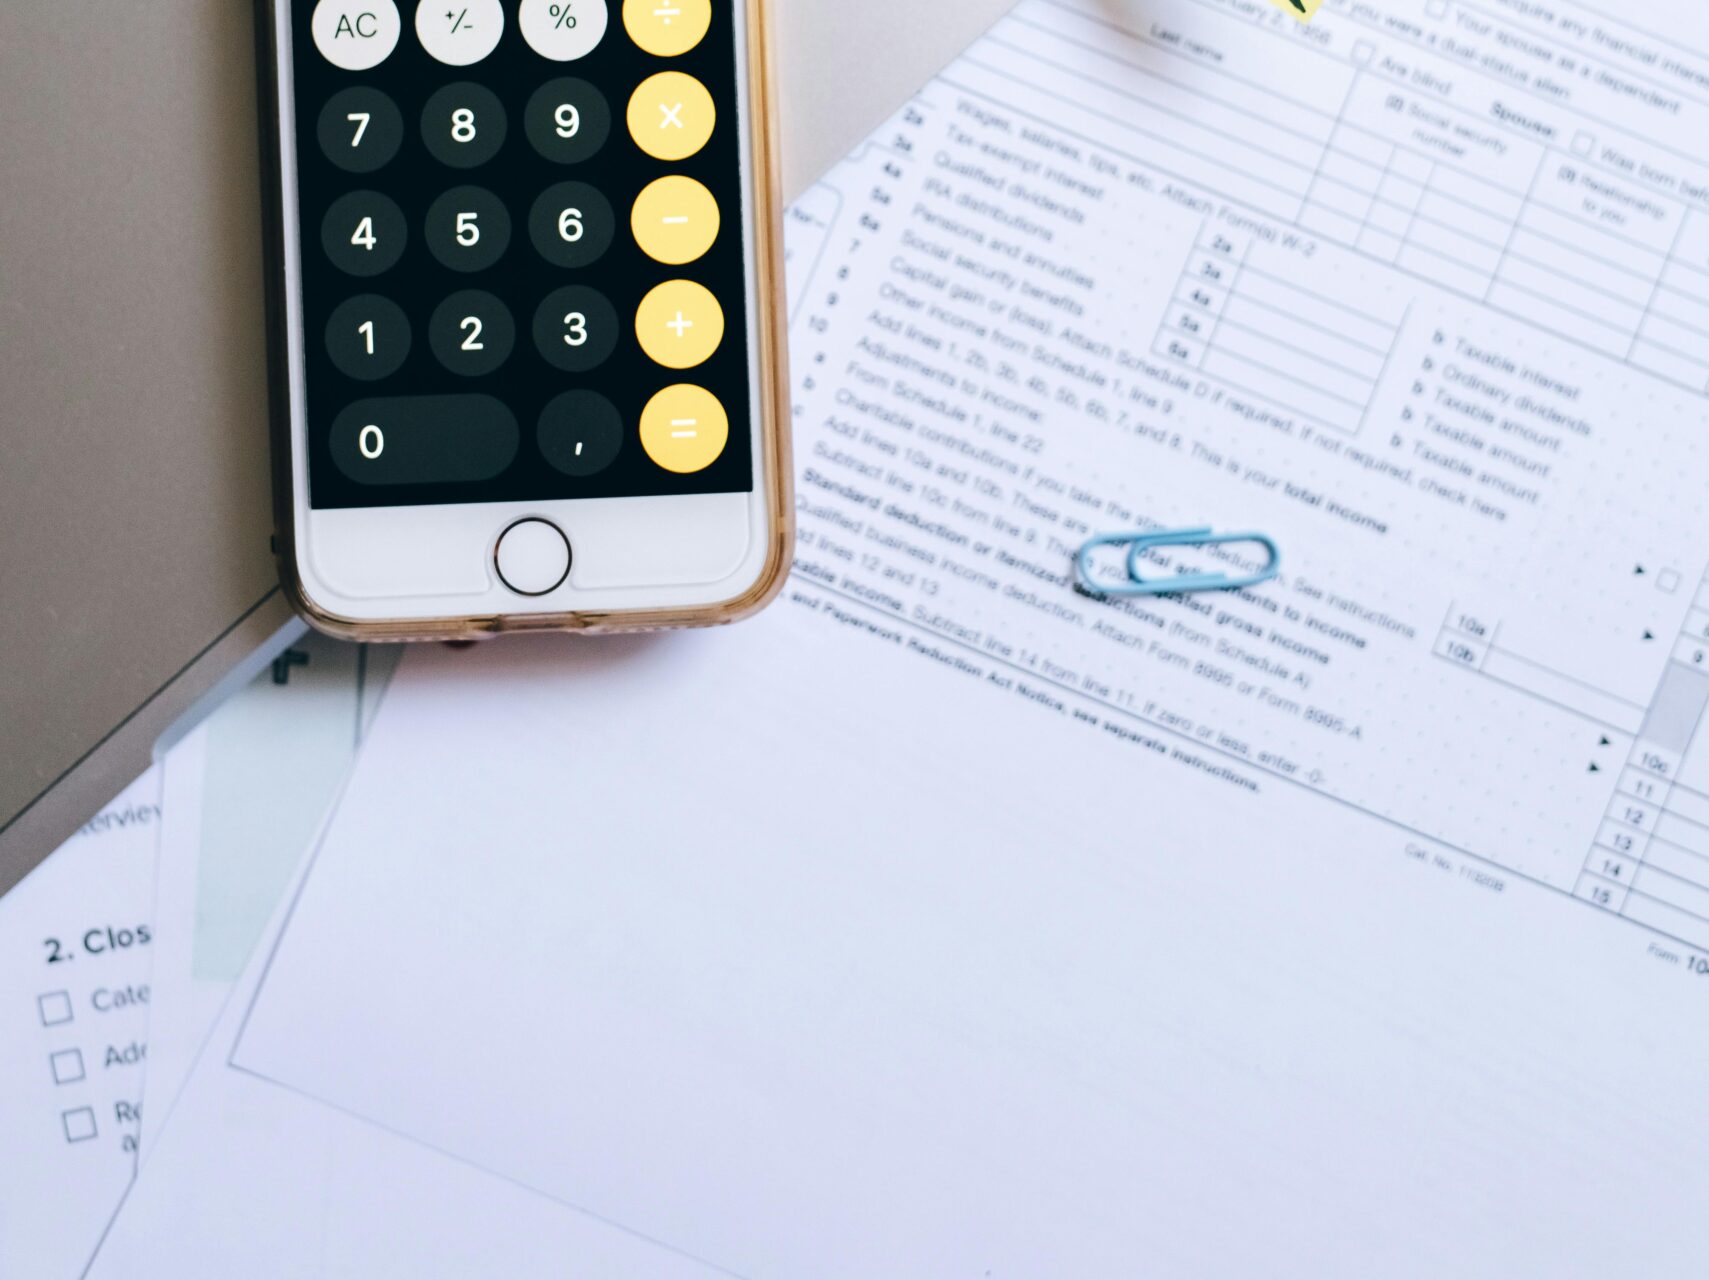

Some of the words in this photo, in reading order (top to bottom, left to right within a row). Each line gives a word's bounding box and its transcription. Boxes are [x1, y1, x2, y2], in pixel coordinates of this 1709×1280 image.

[334, 13, 378, 40] AC
[549, 4, 577, 30] %
[347, 113, 371, 147] 7
[451, 109, 476, 143] 8
[554, 104, 580, 139] 9
[351, 217, 377, 251] 4
[456, 212, 480, 247] 5
[558, 208, 583, 242] 6
[358, 321, 374, 355] 1
[460, 317, 484, 351] 2
[563, 312, 588, 346] 3
[666, 312, 693, 337] +
[358, 424, 384, 459] 0
[671, 418, 697, 438] =
[45, 938, 73, 962] 2.
[84, 926, 151, 956] Clos
